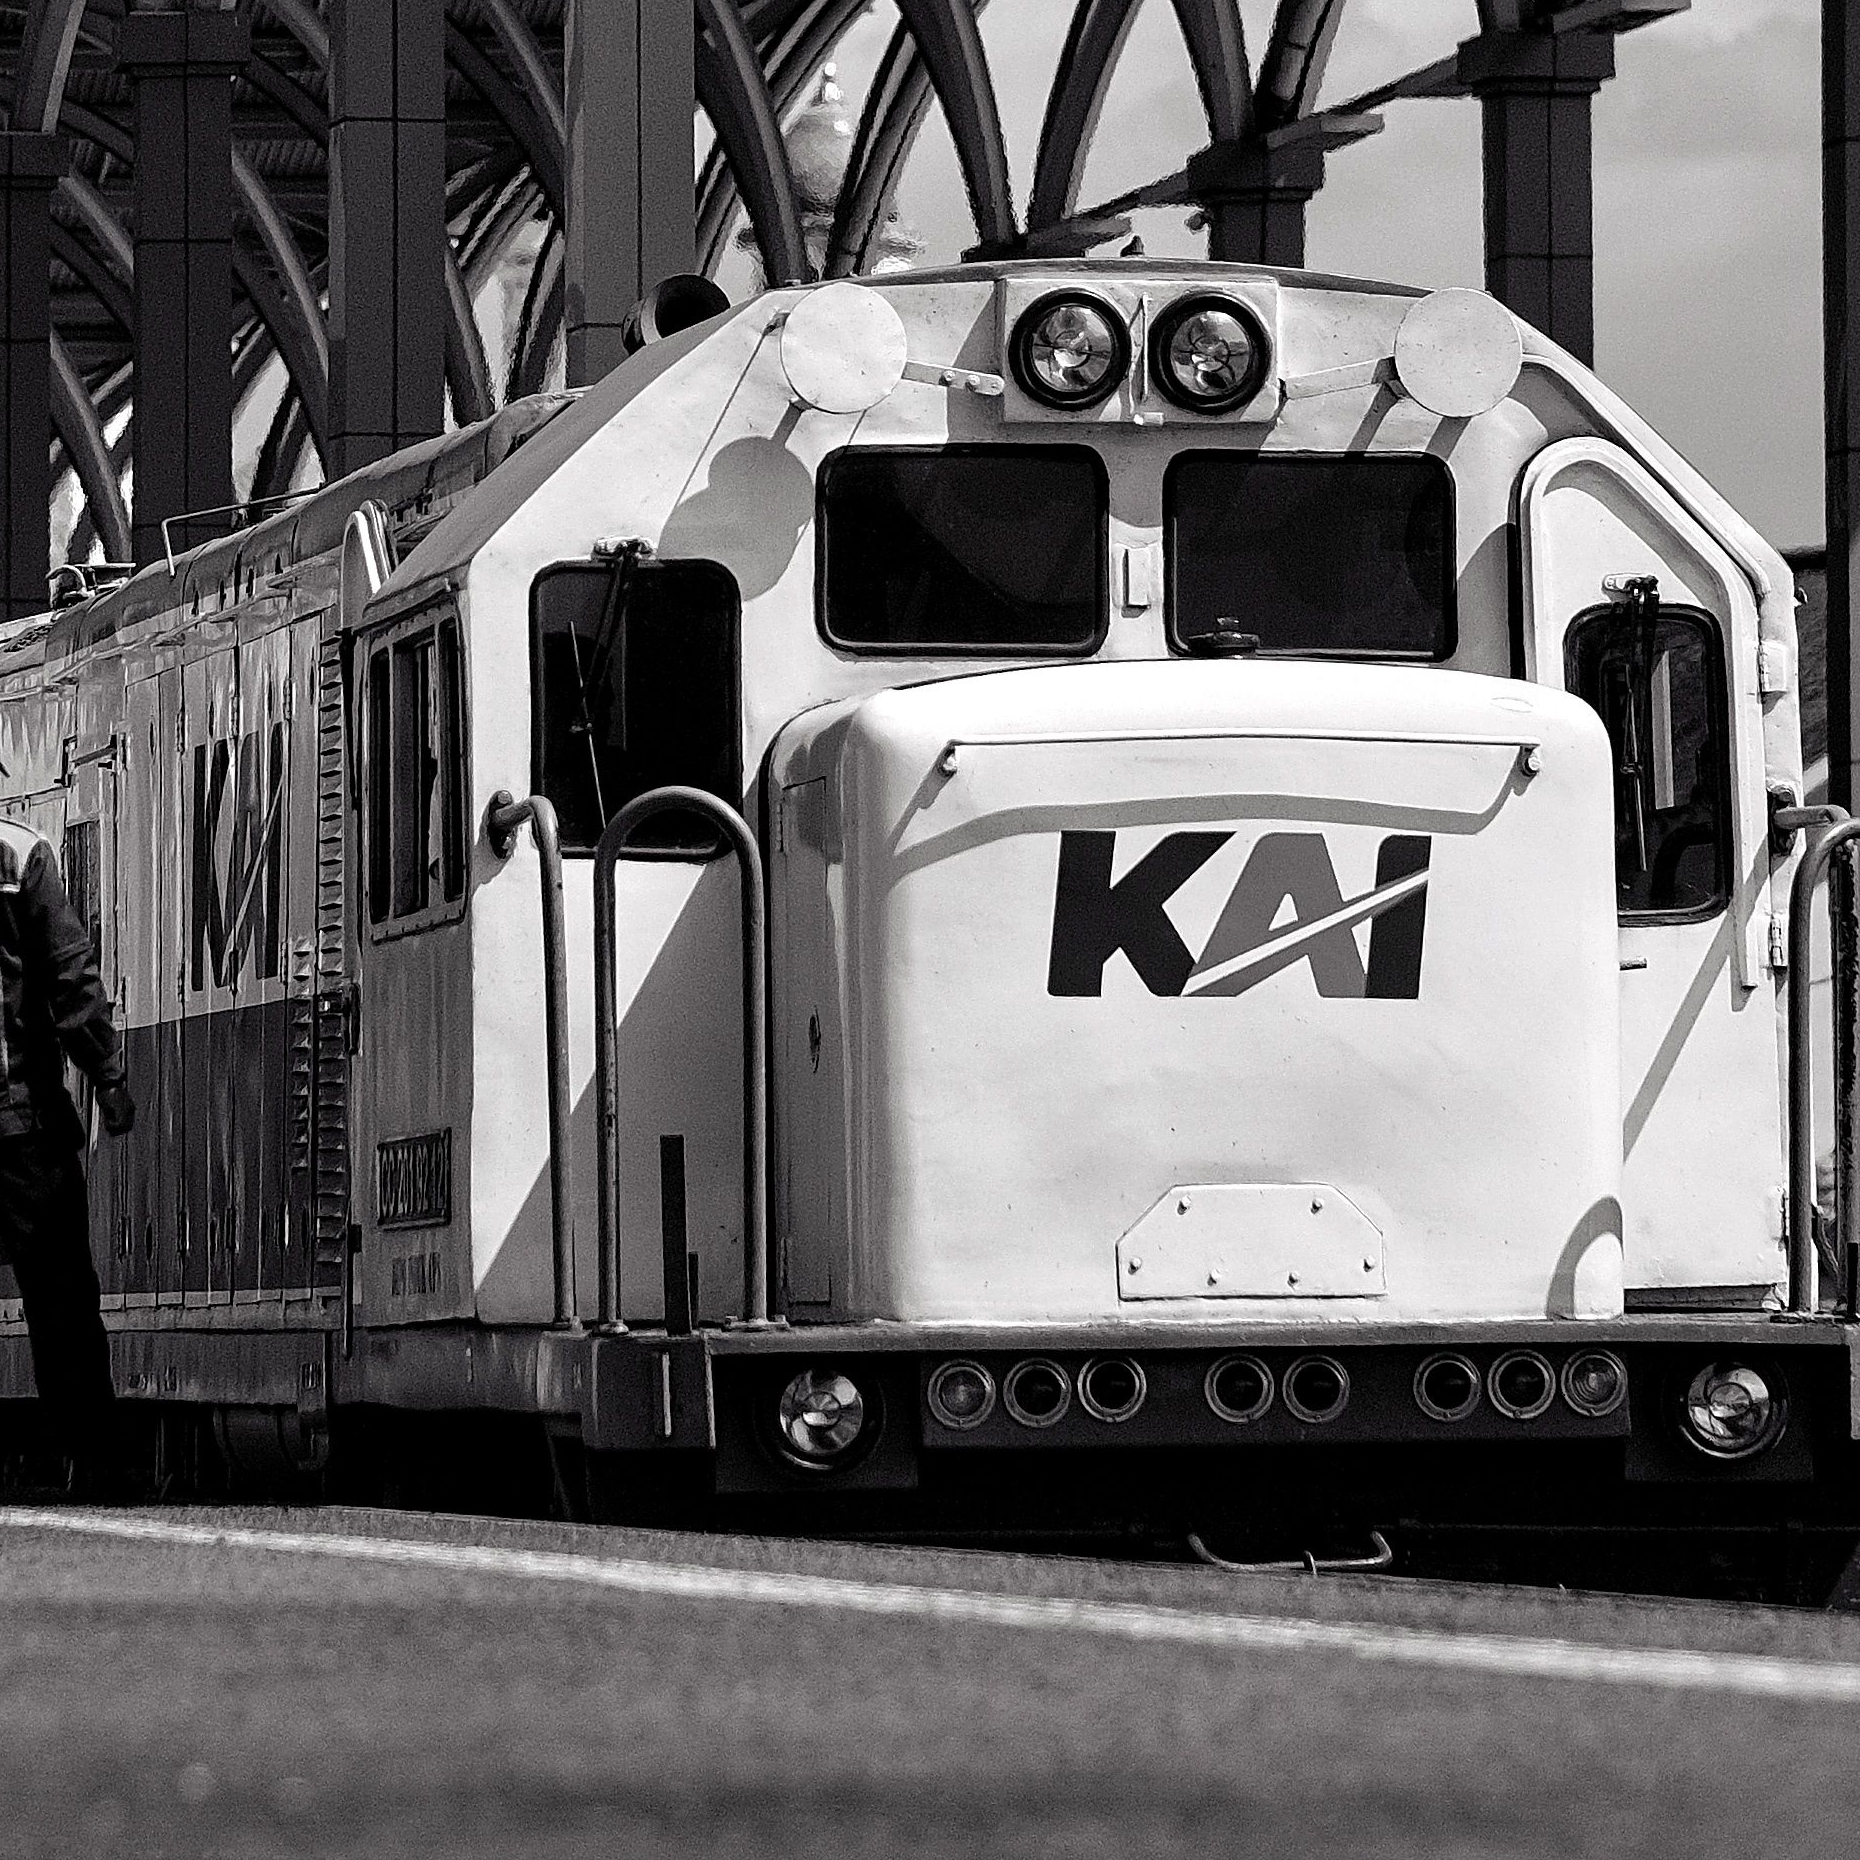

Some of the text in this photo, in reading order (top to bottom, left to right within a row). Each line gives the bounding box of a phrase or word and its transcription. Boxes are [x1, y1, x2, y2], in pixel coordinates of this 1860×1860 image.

[191, 721, 284, 992] KAI
[1047, 830, 1431, 999] KAI
[381, 1148, 395, 1218] CC
[397, 1146, 414, 1214] 201
